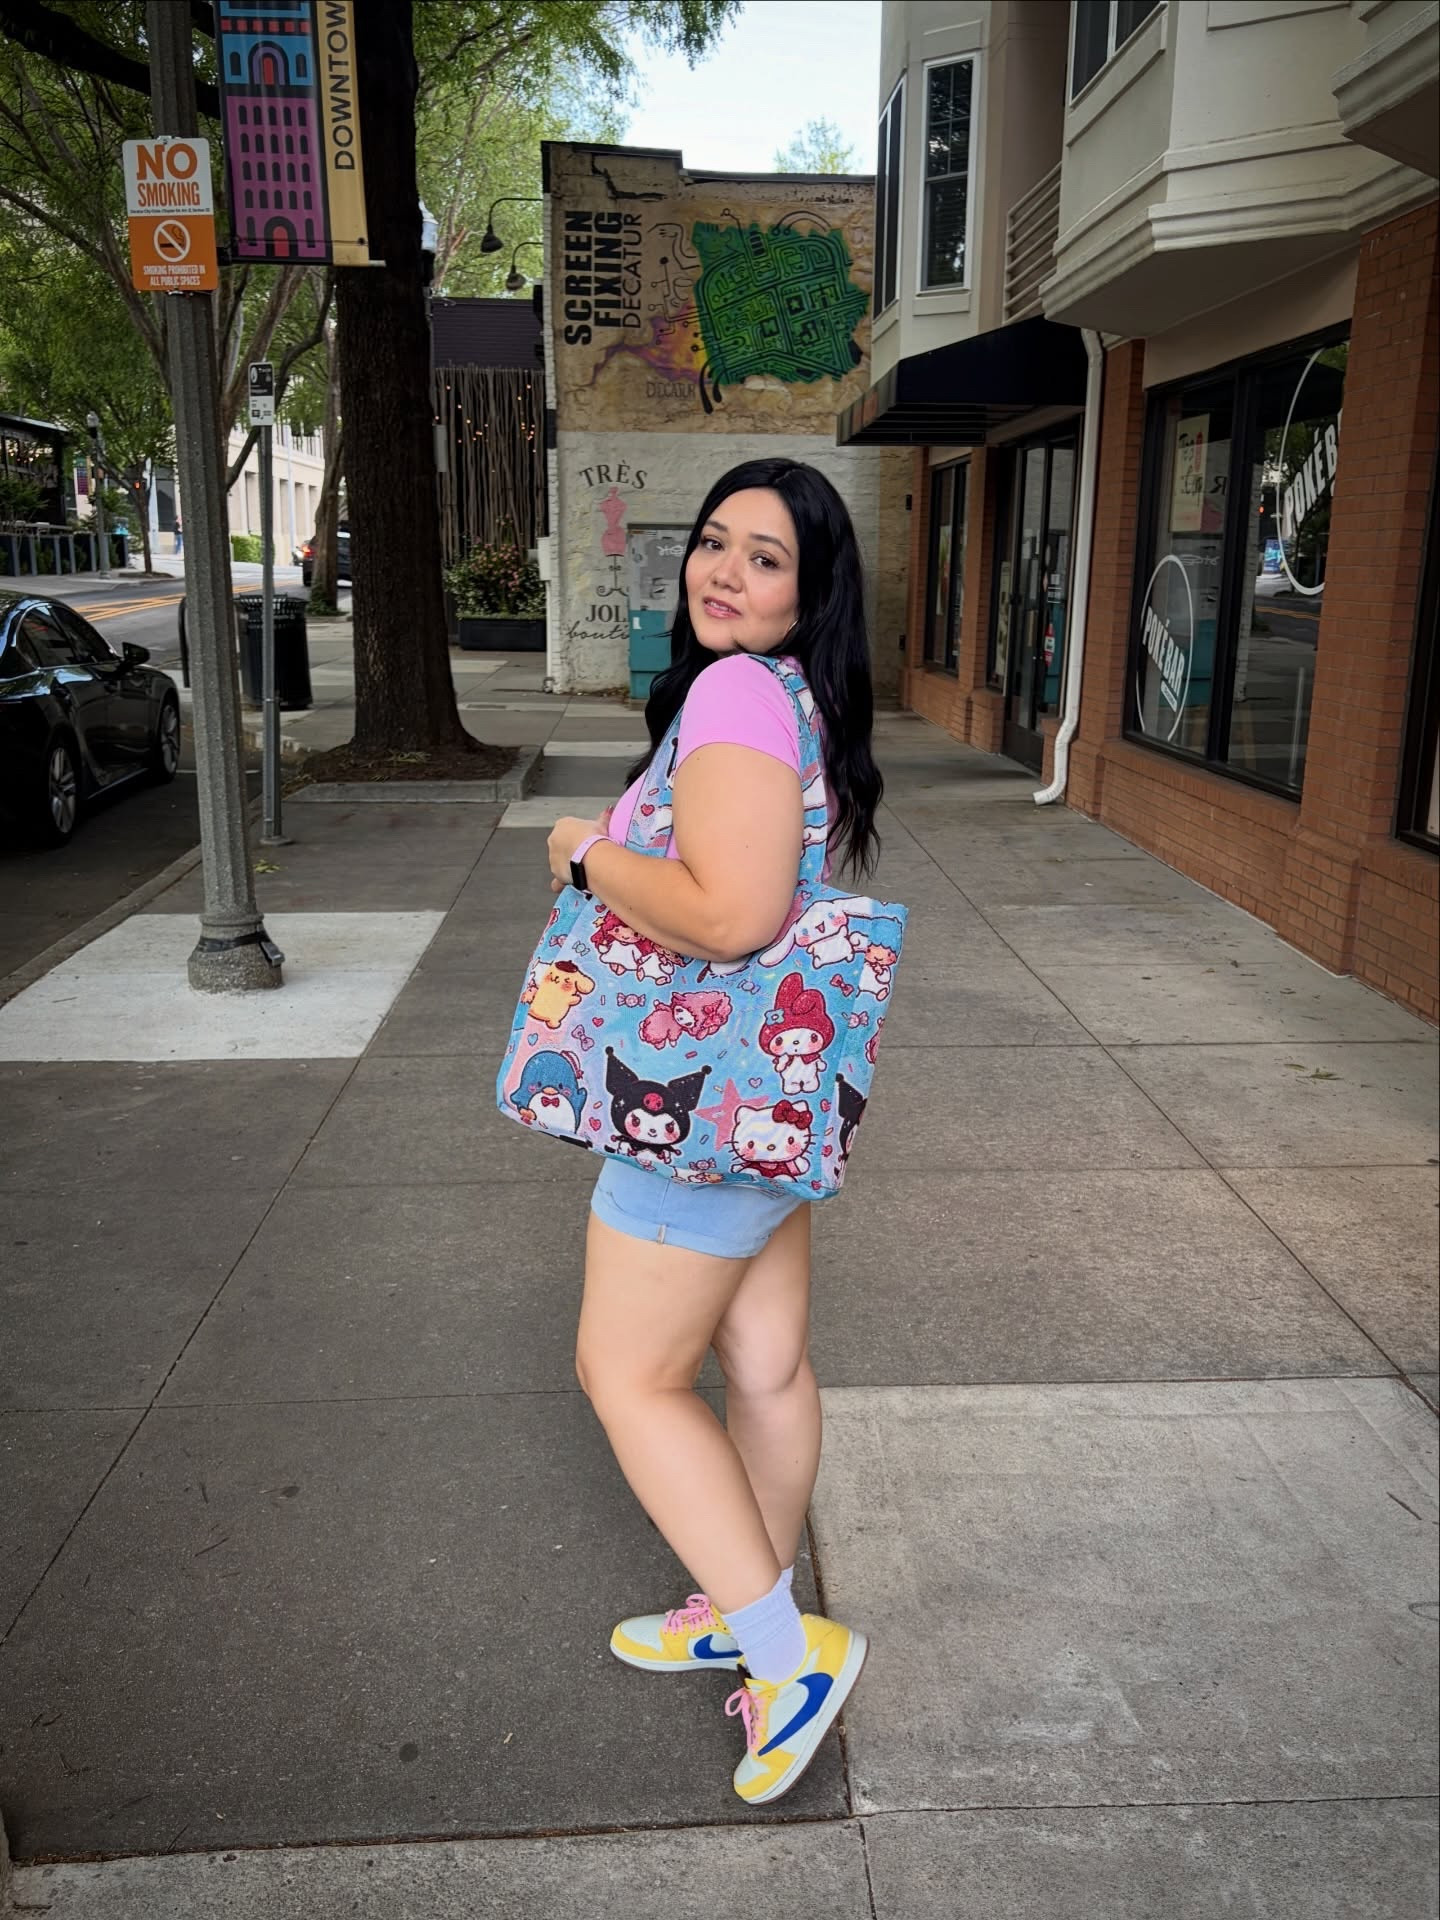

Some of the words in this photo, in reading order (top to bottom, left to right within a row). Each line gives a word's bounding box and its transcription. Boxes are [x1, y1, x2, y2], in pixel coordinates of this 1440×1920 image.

[326, 1, 356, 171] DOWNTOW
[136, 143, 198, 180] NO
[137, 181, 201, 207] SMOKING
[143, 265, 167, 275] SMOKING
[168, 264, 199, 275] PROHIBITED
[199, 264, 206, 275] IN
[150, 276, 160, 286] ALL
[160, 275, 180, 286] PUBLIC
[180, 275, 201, 286] SPACES
[563, 210, 593, 347] SCREEN
[594, 211, 623, 328] FIXING
[622, 213, 642, 329] DECATUR
[579, 460, 648, 489] TRÈS
[585, 604, 628, 623] JOL
[566, 620, 630, 640] bouti
